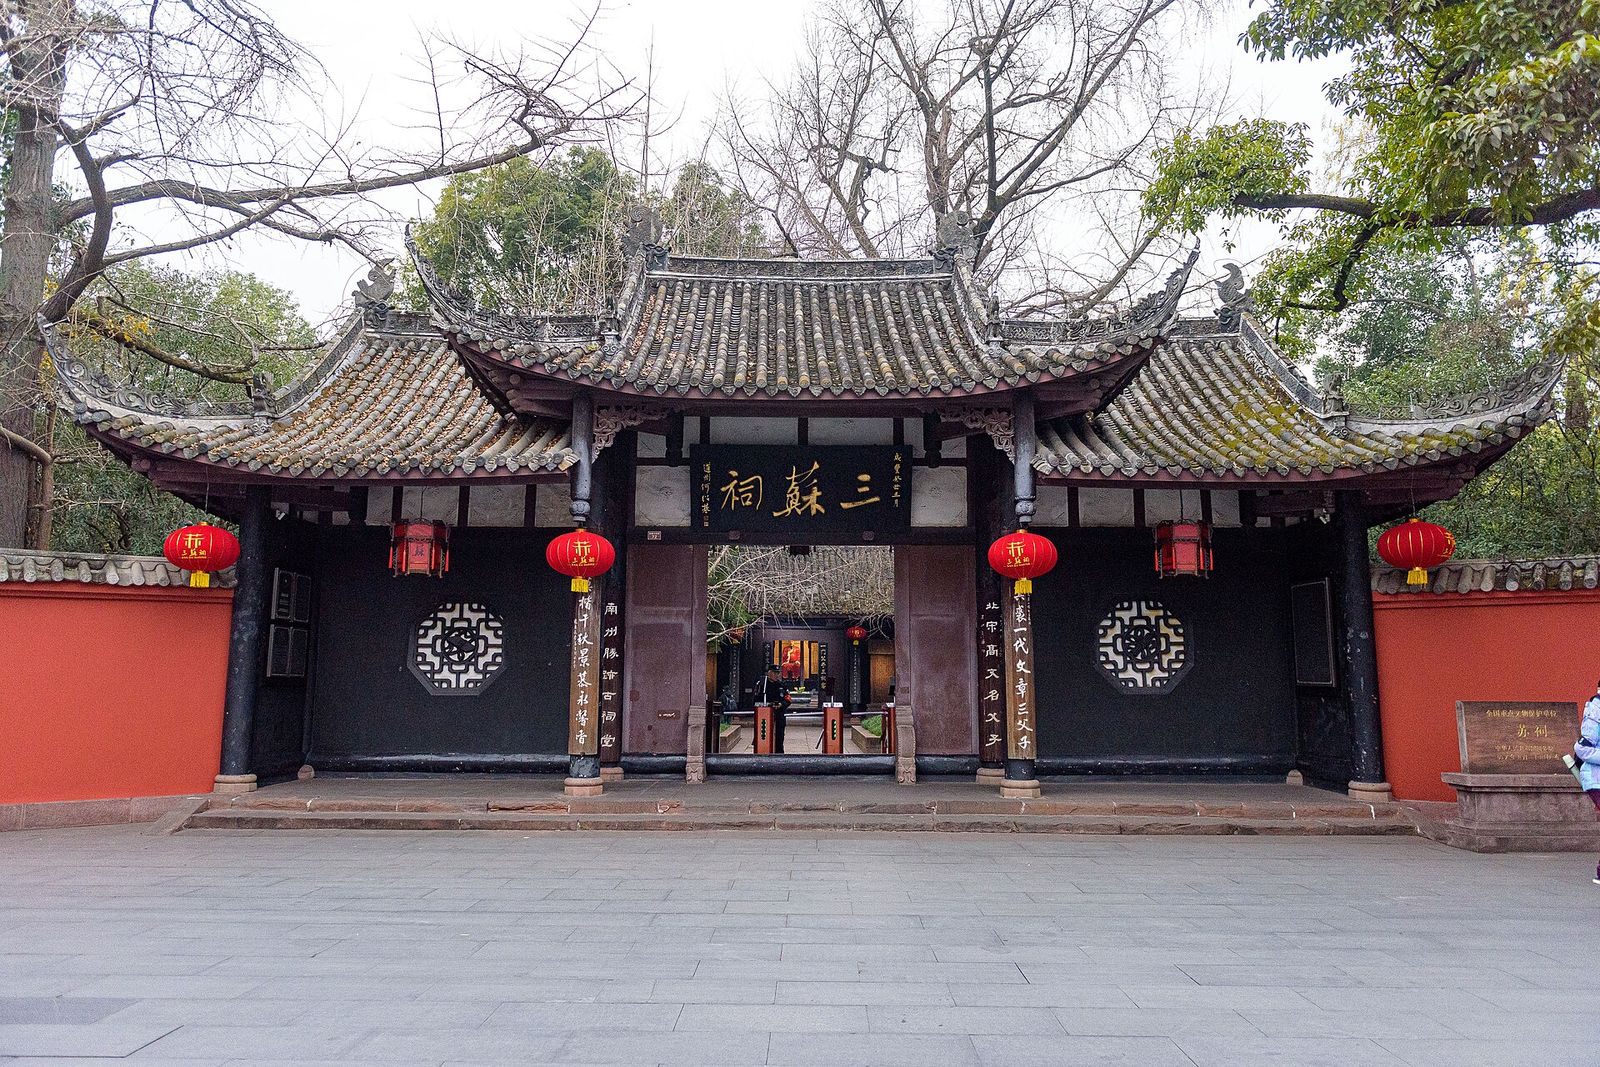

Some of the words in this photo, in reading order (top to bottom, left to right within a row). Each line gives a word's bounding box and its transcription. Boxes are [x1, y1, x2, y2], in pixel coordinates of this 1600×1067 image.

[720, 461, 881, 517] 三蘇祠
[984, 601, 1002, 747] 北宋高文名父子
